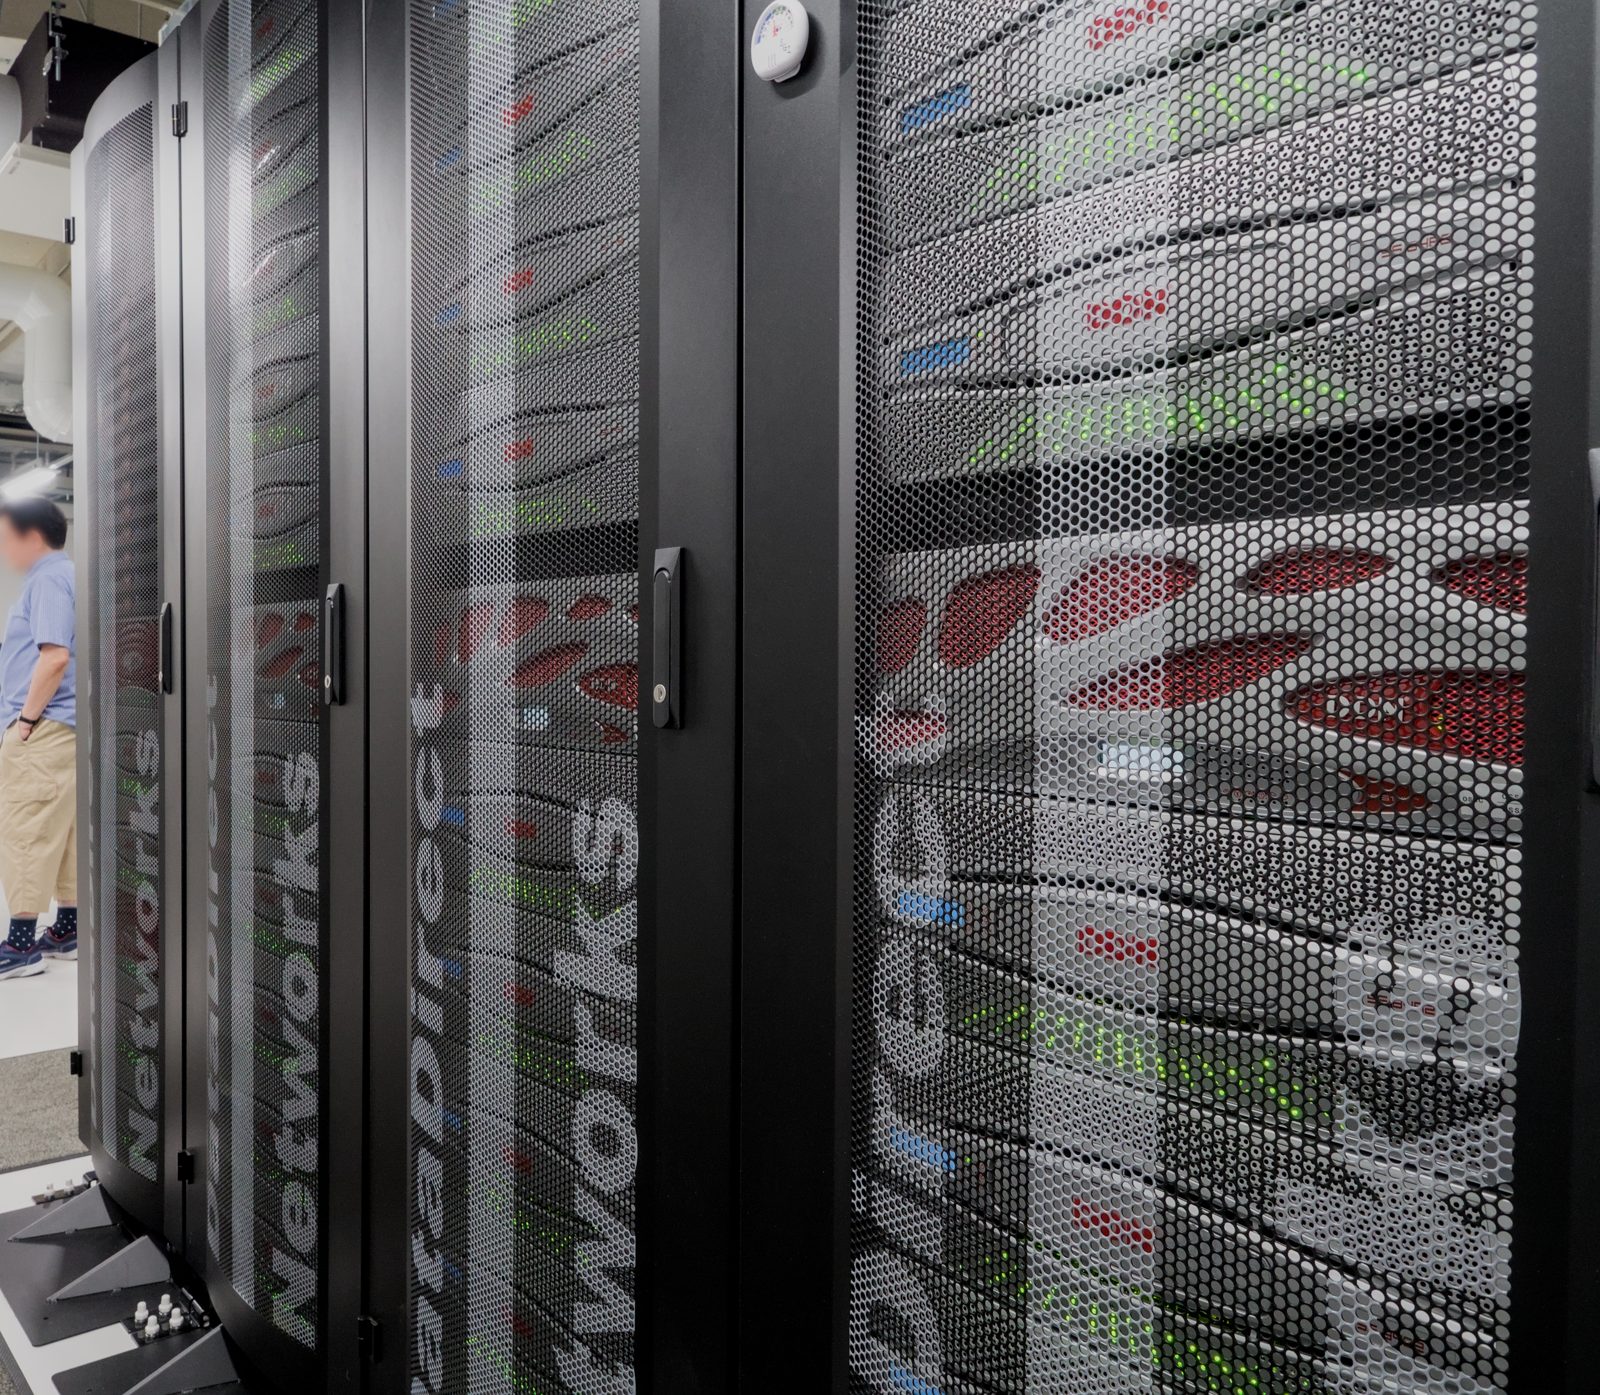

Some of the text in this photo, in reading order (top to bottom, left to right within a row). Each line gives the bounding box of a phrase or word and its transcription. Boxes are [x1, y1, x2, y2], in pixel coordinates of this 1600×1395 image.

[129, 727, 159, 1183] Networks
[273, 751, 319, 1350] Networks
[410, 681, 444, 1395] ataDirect
